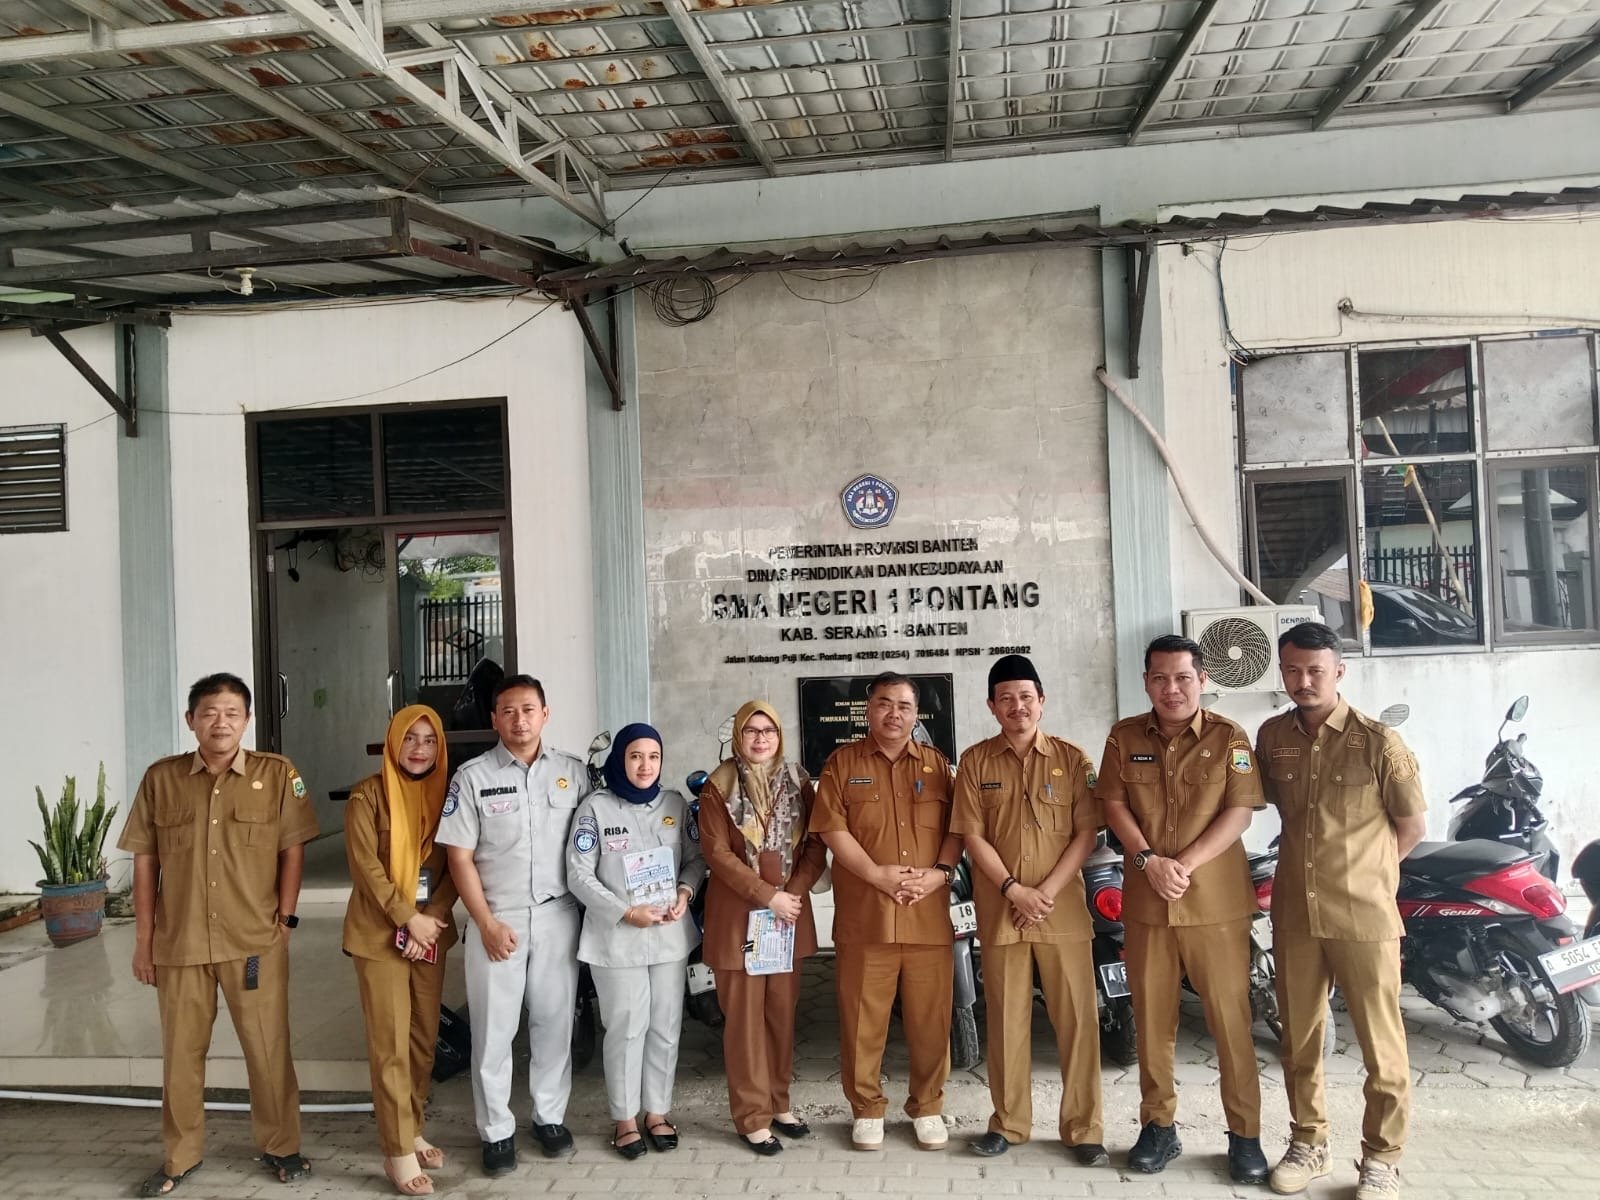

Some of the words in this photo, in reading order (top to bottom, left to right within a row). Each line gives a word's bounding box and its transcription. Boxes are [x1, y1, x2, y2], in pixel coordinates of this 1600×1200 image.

[768, 543, 852, 559] PEMERINTAH
[855, 541, 919, 557] PROVINSI
[922, 537, 979, 554] BANTEN
[747, 568, 788, 583] DINAS
[791, 564, 874, 581] PENDIDIKAN
[877, 563, 907, 578] DAN
[910, 560, 1004, 576] KEBUDAYAAN
[712, 593, 769, 619] SMA
[778, 589, 877, 617] NEGERI
[888, 588, 898, 613] 1
[909, 582, 1040, 613] PONTANG
[780, 628, 818, 641] KAB.
[824, 624, 888, 640] SERANG
[904, 622, 968, 638] BANTEN
[724, 655, 745, 664] Jalan
[749, 654, 780, 664] Kubang
[782, 653, 798, 664] Puji
[819, 652, 852, 662] Pontang
[881, 649, 910, 661] (0254)
[604, 826, 629, 836] RISA
[1438, 908, 1484, 917] Genio
[1561, 947, 1590, 966] 5054
[690, 967, 696, 979] A
